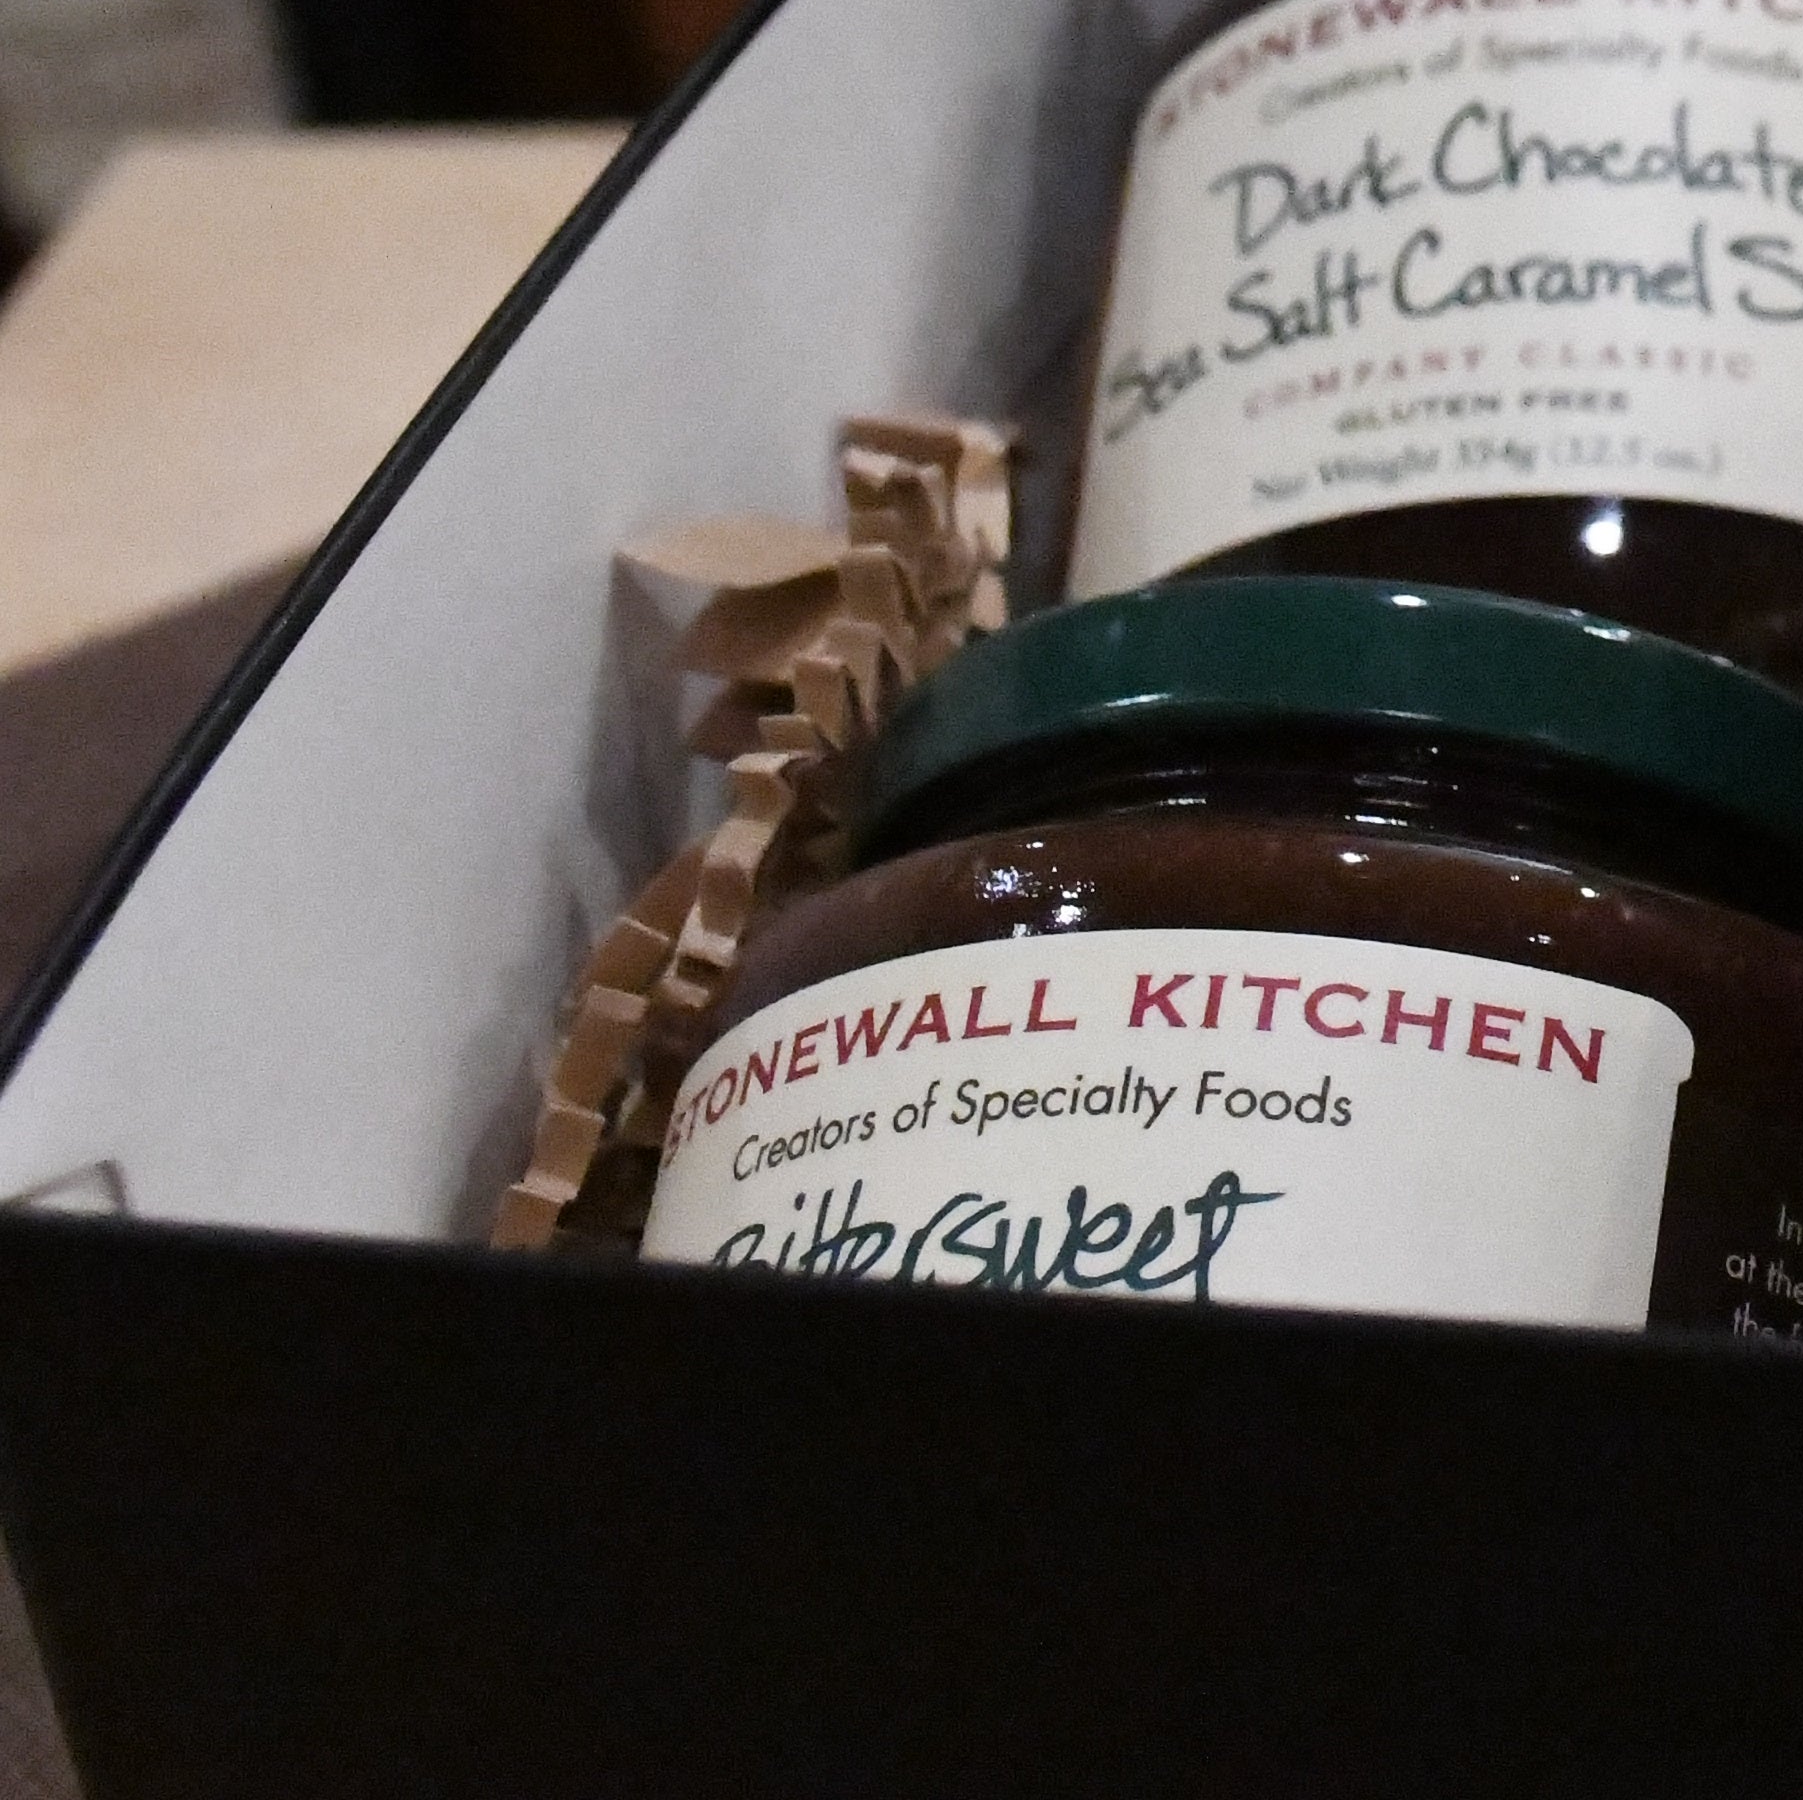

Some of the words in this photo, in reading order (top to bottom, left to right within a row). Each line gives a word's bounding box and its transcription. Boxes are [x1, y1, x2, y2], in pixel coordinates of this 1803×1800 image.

[1208, 132, 1420, 255] Dark
[1219, 248, 1380, 363] Salt
[1394, 222, 1713, 318] Caramel
[661, 978, 1078, 1170] STONEWALL
[1127, 973, 1608, 1086] KITCHEN
[732, 1109, 876, 1183] Creators
[892, 1079, 941, 1134] of
[950, 1066, 1178, 1137] Specialty
[1196, 1069, 1355, 1130] Foods
[1724, 1252, 1758, 1285] at
